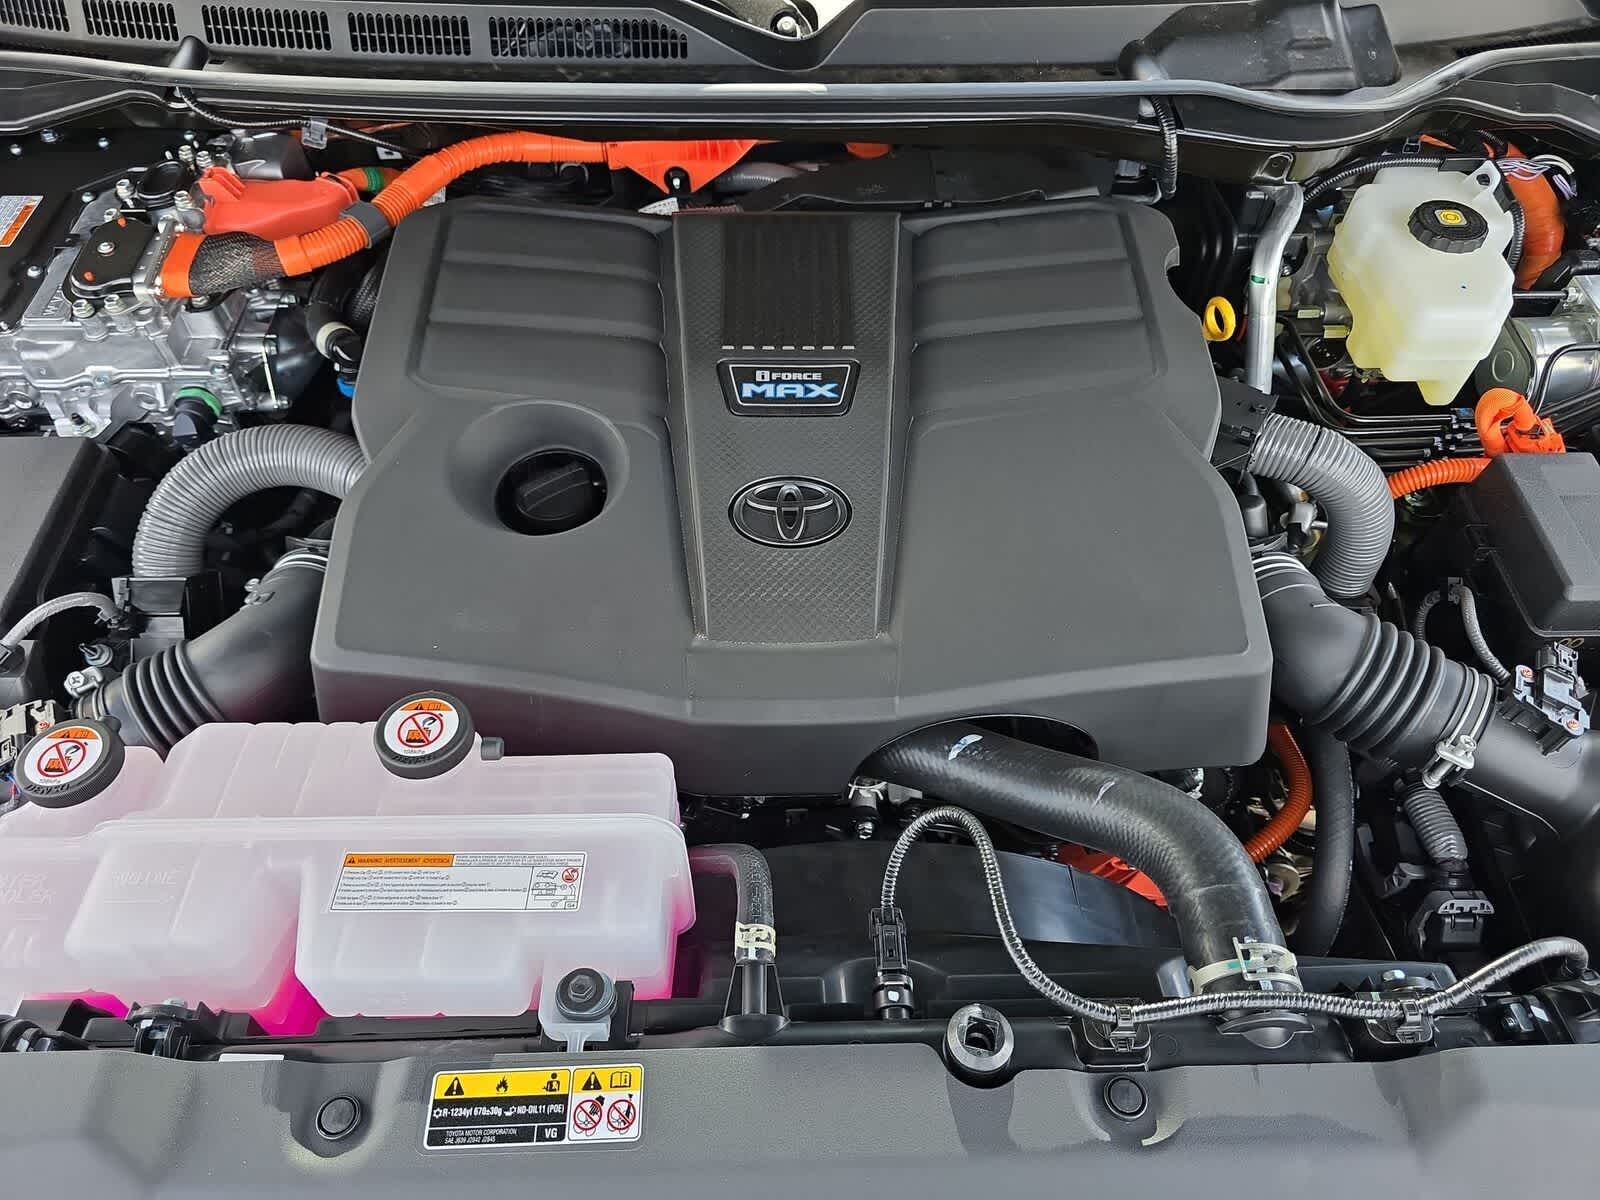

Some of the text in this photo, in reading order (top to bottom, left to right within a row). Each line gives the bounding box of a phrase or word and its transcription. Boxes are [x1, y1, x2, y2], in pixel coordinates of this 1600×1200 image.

[771, 372, 822, 381] FORCE
[741, 382, 839, 399] MAX
[442, 1107, 473, 1118] R-1234yf
[547, 1103, 565, 1115] (POE)
[465, 1129, 483, 1137] MOTOR
[483, 1128, 517, 1136] CORPORATION
[545, 1127, 558, 1139] VG
